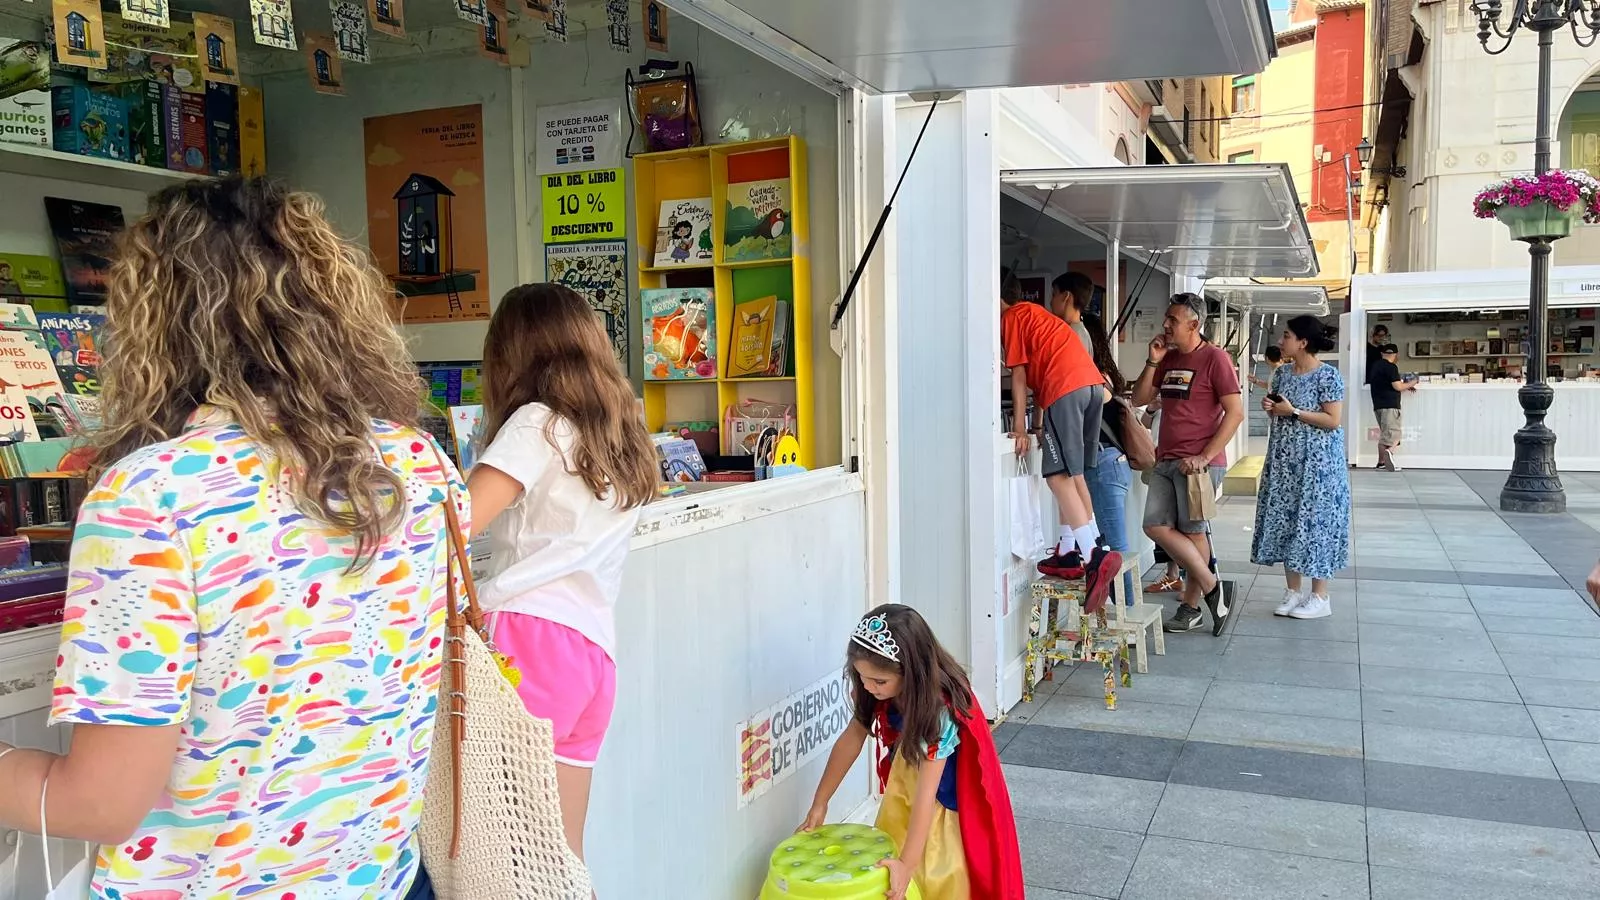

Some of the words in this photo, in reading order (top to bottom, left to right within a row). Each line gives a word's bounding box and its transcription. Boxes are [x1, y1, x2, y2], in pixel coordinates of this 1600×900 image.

[170, 106, 181, 141] SIRENAS
[546, 120, 556, 129] SE
[557, 117, 581, 127] PUEDE
[583, 114, 609, 124] PAGAR
[422, 127, 440, 135] FERIA
[451, 132, 475, 140] HUESCA
[546, 129, 563, 138] CON
[564, 126, 596, 136] TARJETA
[597, 124, 608, 133] DE
[561, 136, 593, 146] CREDITO
[547, 176, 562, 188] DIA
[567, 174, 584, 186] DEL
[588, 171, 616, 184] LIBRO
[750, 185, 775, 198] Cuando
[557, 194, 580, 215] 10
[587, 192, 606, 213] %
[551, 222, 613, 236] DESCUENTO
[14, 360, 48, 370] ERTOS
[736, 420, 745, 433] El
[771, 679, 840, 740] GOBIERNO
[772, 738, 791, 776] DE
[796, 706, 849, 759] ARAGON
